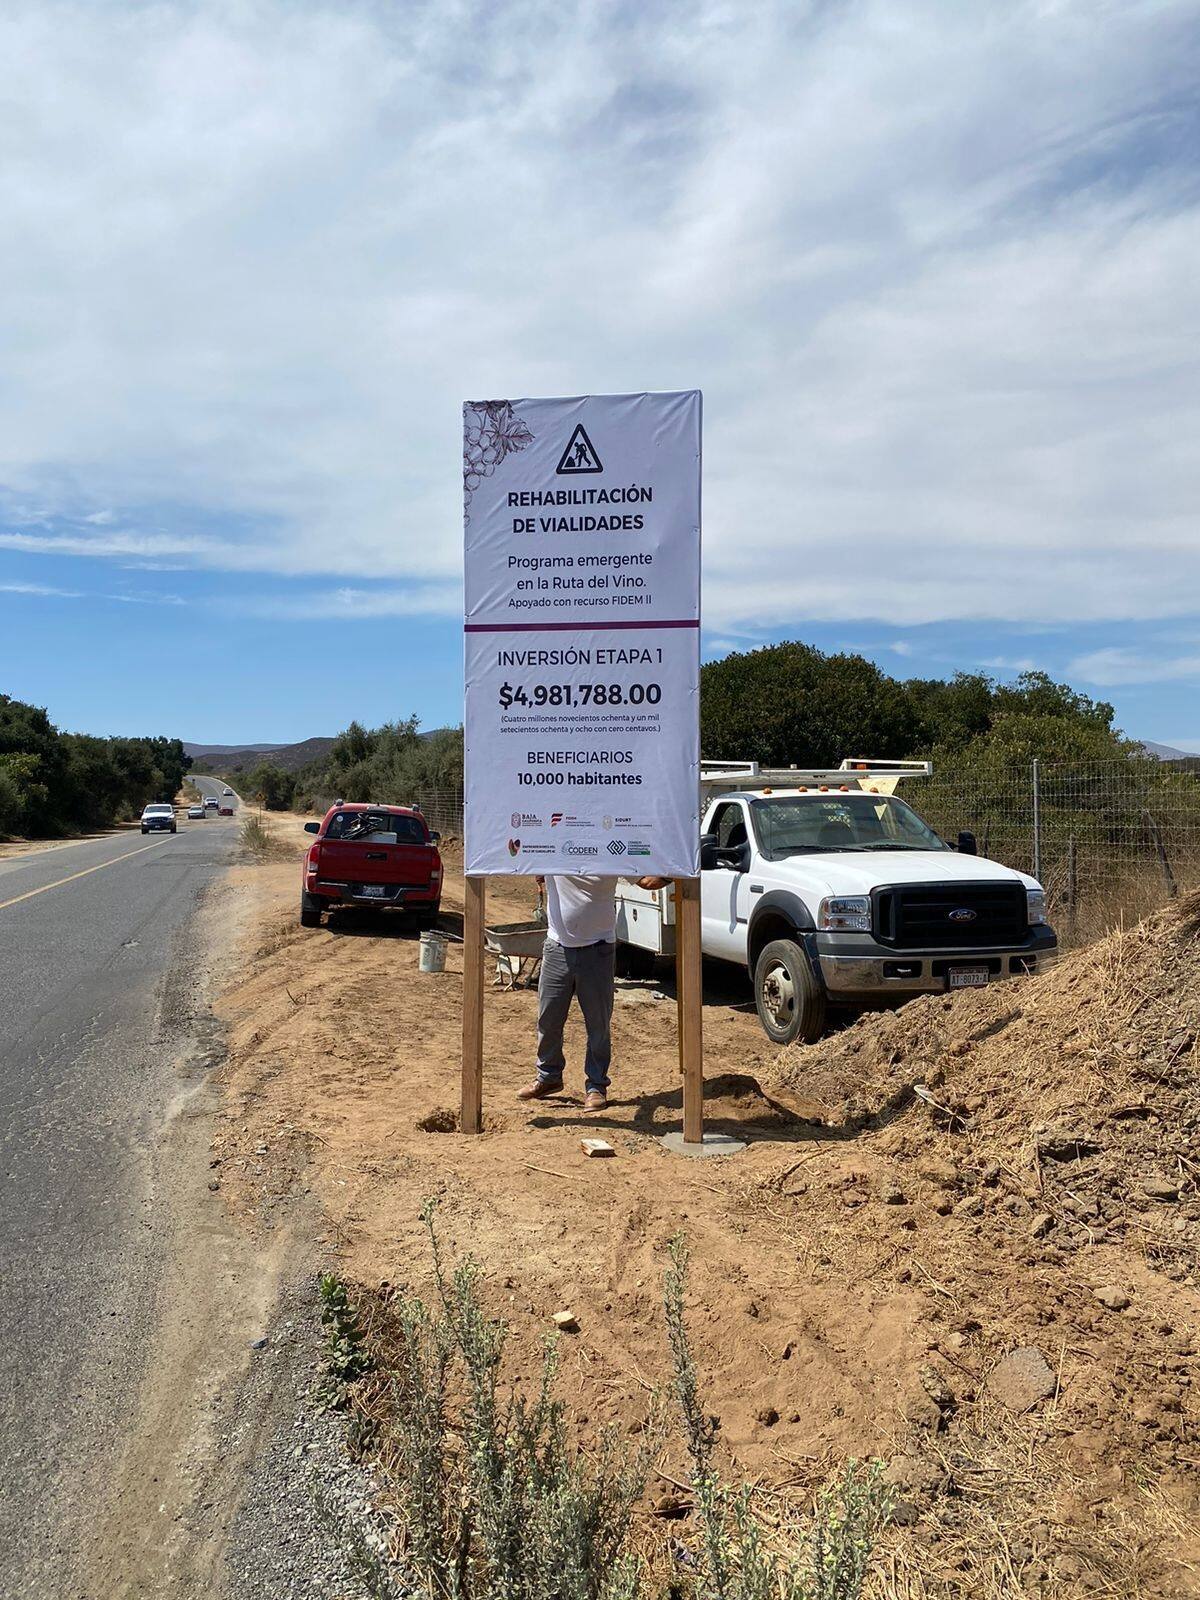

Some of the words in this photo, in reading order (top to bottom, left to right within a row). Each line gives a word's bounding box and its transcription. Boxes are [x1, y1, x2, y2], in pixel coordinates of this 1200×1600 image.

[508, 484, 652, 507] REHABILITACIÓN
[512, 518, 536, 534] DE
[539, 514, 644, 533] VIALIDADES
[508, 556, 574, 571] Programa
[578, 553, 653, 569] emergente
[516, 579, 534, 591] en
[537, 577, 549, 590] la
[552, 576, 584, 591] Ruta
[587, 575, 609, 590] del
[612, 574, 647, 589] Vino.
[508, 597, 552, 610] Apoyado
[553, 598, 571, 607] con
[574, 597, 610, 607] recurso
[612, 595, 644, 606] FIDEM
[645, 595, 652, 605] II
[497, 646, 591, 667] INVERSIÓN
[596, 648, 653, 665] ETAPA
[656, 648, 663, 664] 1
[498, 682, 662, 711] $4,981,788.00
[500, 714, 527, 724] (Cuatro
[528, 714, 558, 723] millones
[558, 714, 600, 723] novecientos
[601, 713, 630, 722] ochenta
[631, 715, 636, 723] y
[637, 714, 647, 722] un
[647, 713, 660, 722] mil
[500, 725, 539, 734] setecientos
[540, 725, 569, 734] ochenta
[569, 726, 575, 735] y
[575, 725, 593, 733] ocho
[625, 724, 661, 734] centavos.)
[527, 750, 633, 765] BENEFICIARIOS
[517, 772, 564, 787] 10,000
[567, 771, 643, 786] habitantes
[568, 846, 598, 854] CODEEN
